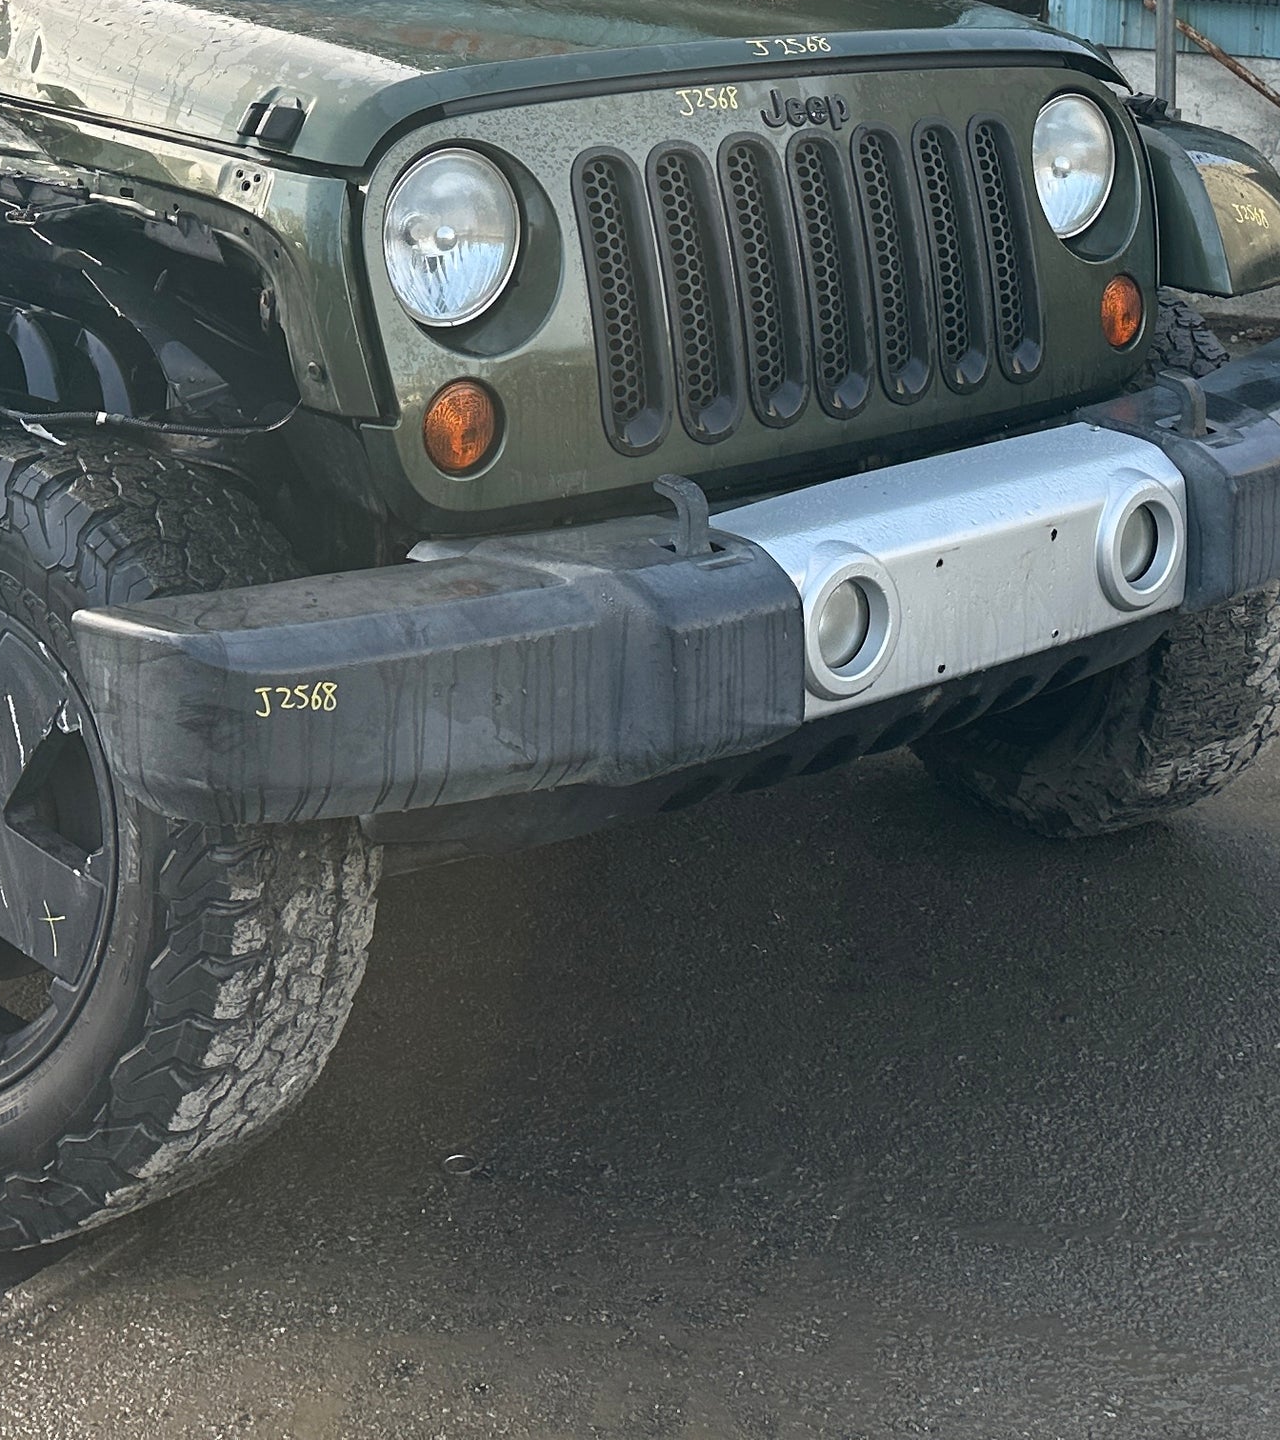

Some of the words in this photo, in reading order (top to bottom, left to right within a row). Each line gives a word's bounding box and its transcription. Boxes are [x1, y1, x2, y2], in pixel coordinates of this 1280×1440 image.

[745, 35, 832, 57] J2568
[675, 85, 738, 116] J2568
[760, 88, 851, 131] Jeep
[254, 681, 338, 717] J2568
